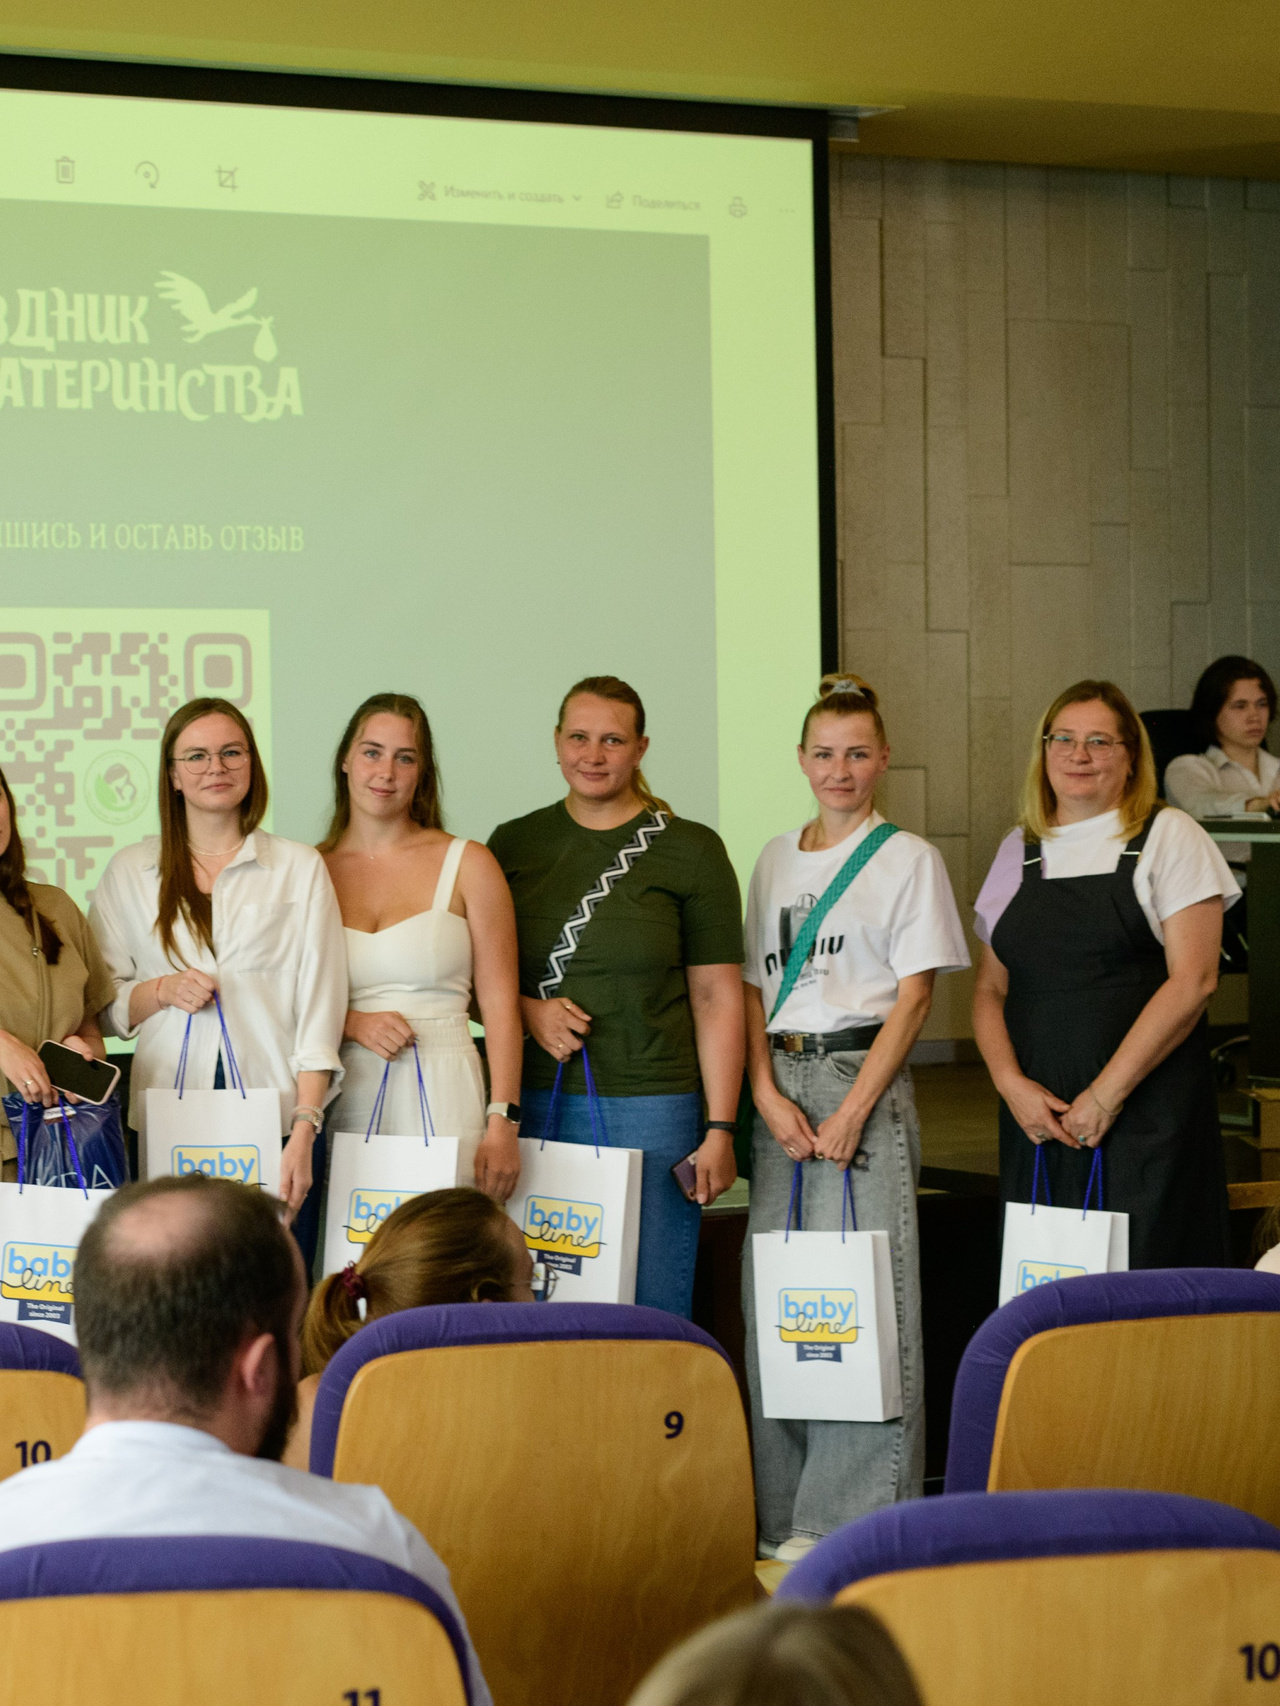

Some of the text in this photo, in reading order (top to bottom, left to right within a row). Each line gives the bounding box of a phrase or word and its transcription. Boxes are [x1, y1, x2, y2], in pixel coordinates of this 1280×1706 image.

[88, 522, 108, 549] И
[117, 523, 214, 551] ОСТАВЬ
[220, 525, 305, 552] ОТЗЫВ
[177, 1151, 255, 1183] baby
[354, 1194, 402, 1221] ba
[528, 1201, 599, 1240] baby
[521, 1220, 608, 1248] line
[7, 1247, 72, 1278] bab
[773, 1311, 865, 1335] line
[784, 1294, 854, 1325] baby
[664, 1410, 685, 1440] 9
[14, 1439, 52, 1469] 10
[1239, 1643, 1280, 1683] 10
